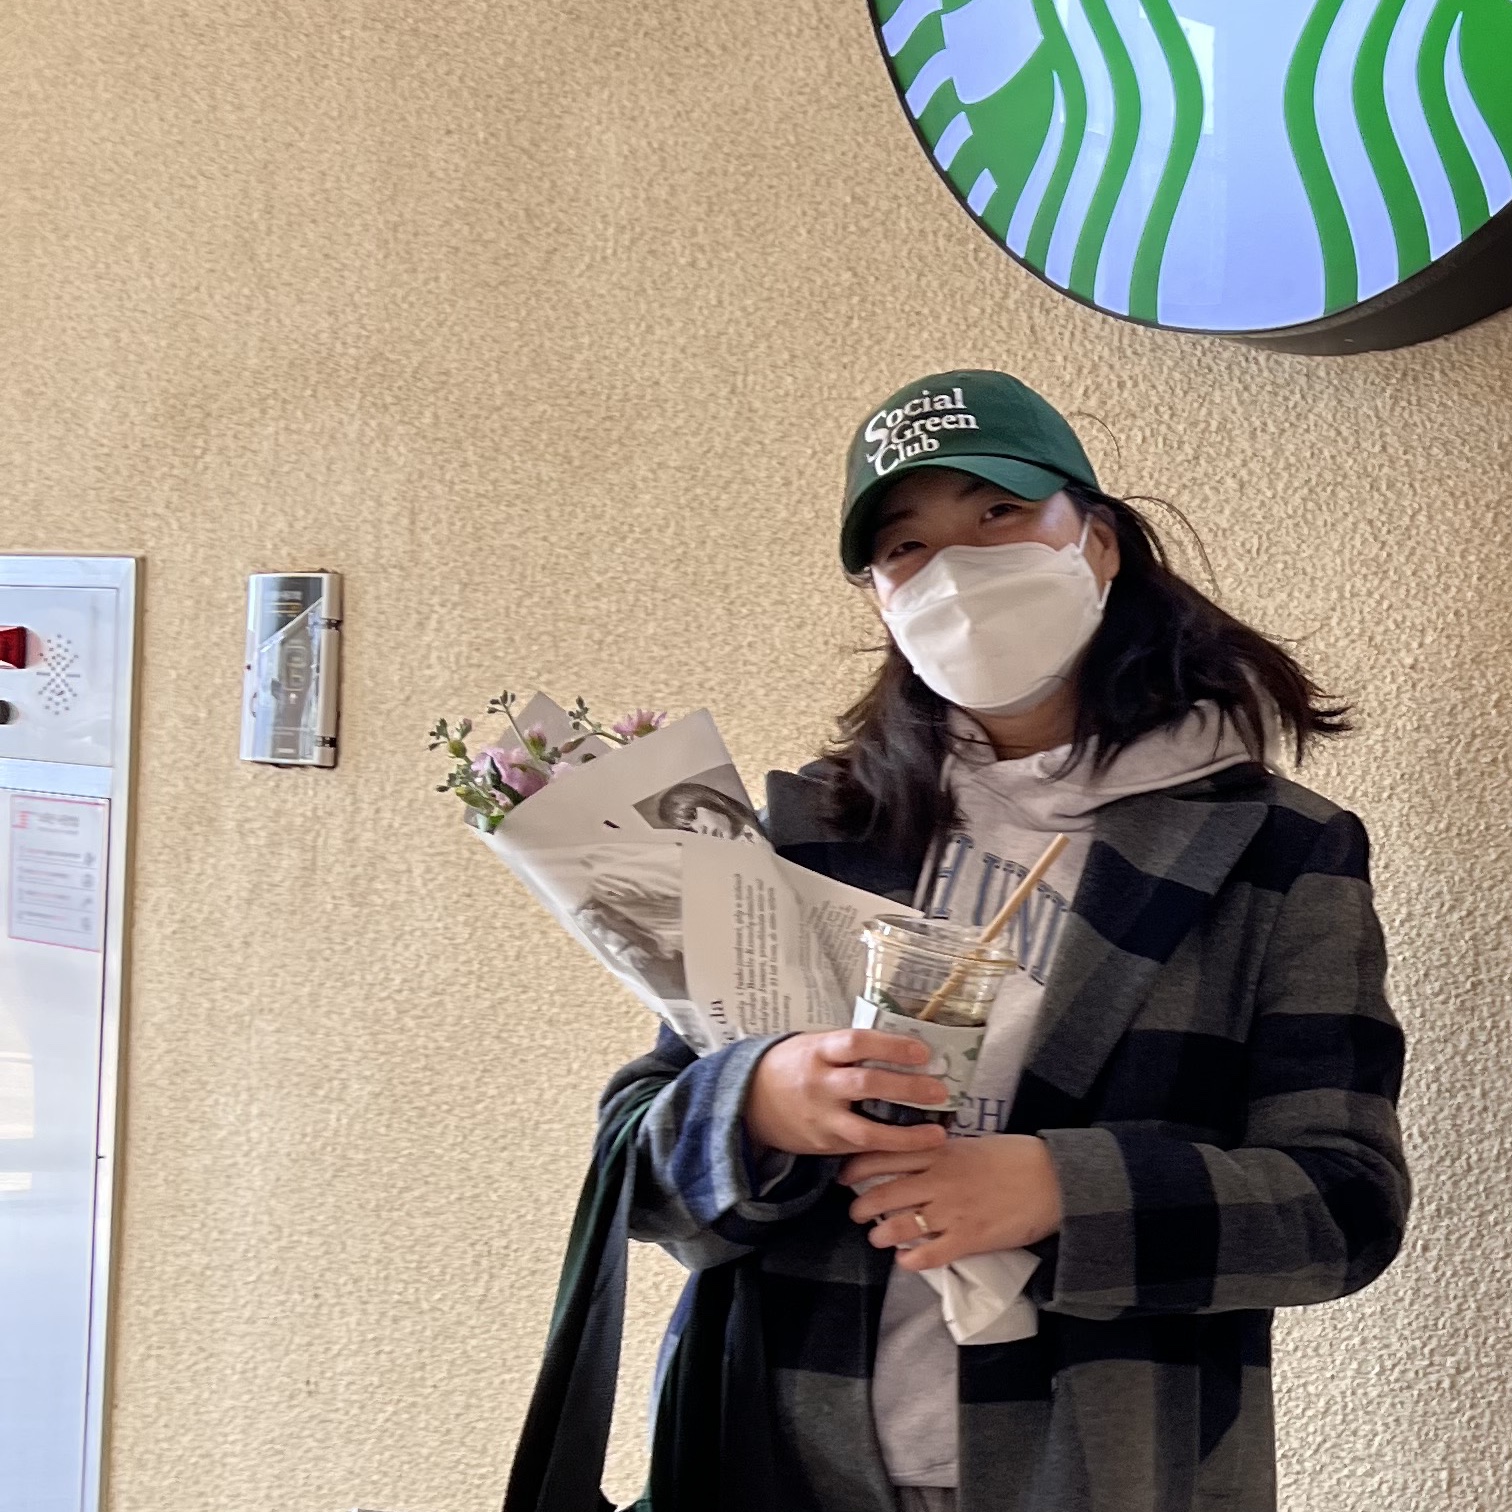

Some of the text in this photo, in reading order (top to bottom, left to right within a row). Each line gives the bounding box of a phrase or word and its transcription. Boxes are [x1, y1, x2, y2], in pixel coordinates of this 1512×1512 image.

[864, 387, 968, 463] Social
[890, 412, 980, 444] Green
[874, 434, 940, 476] Club
